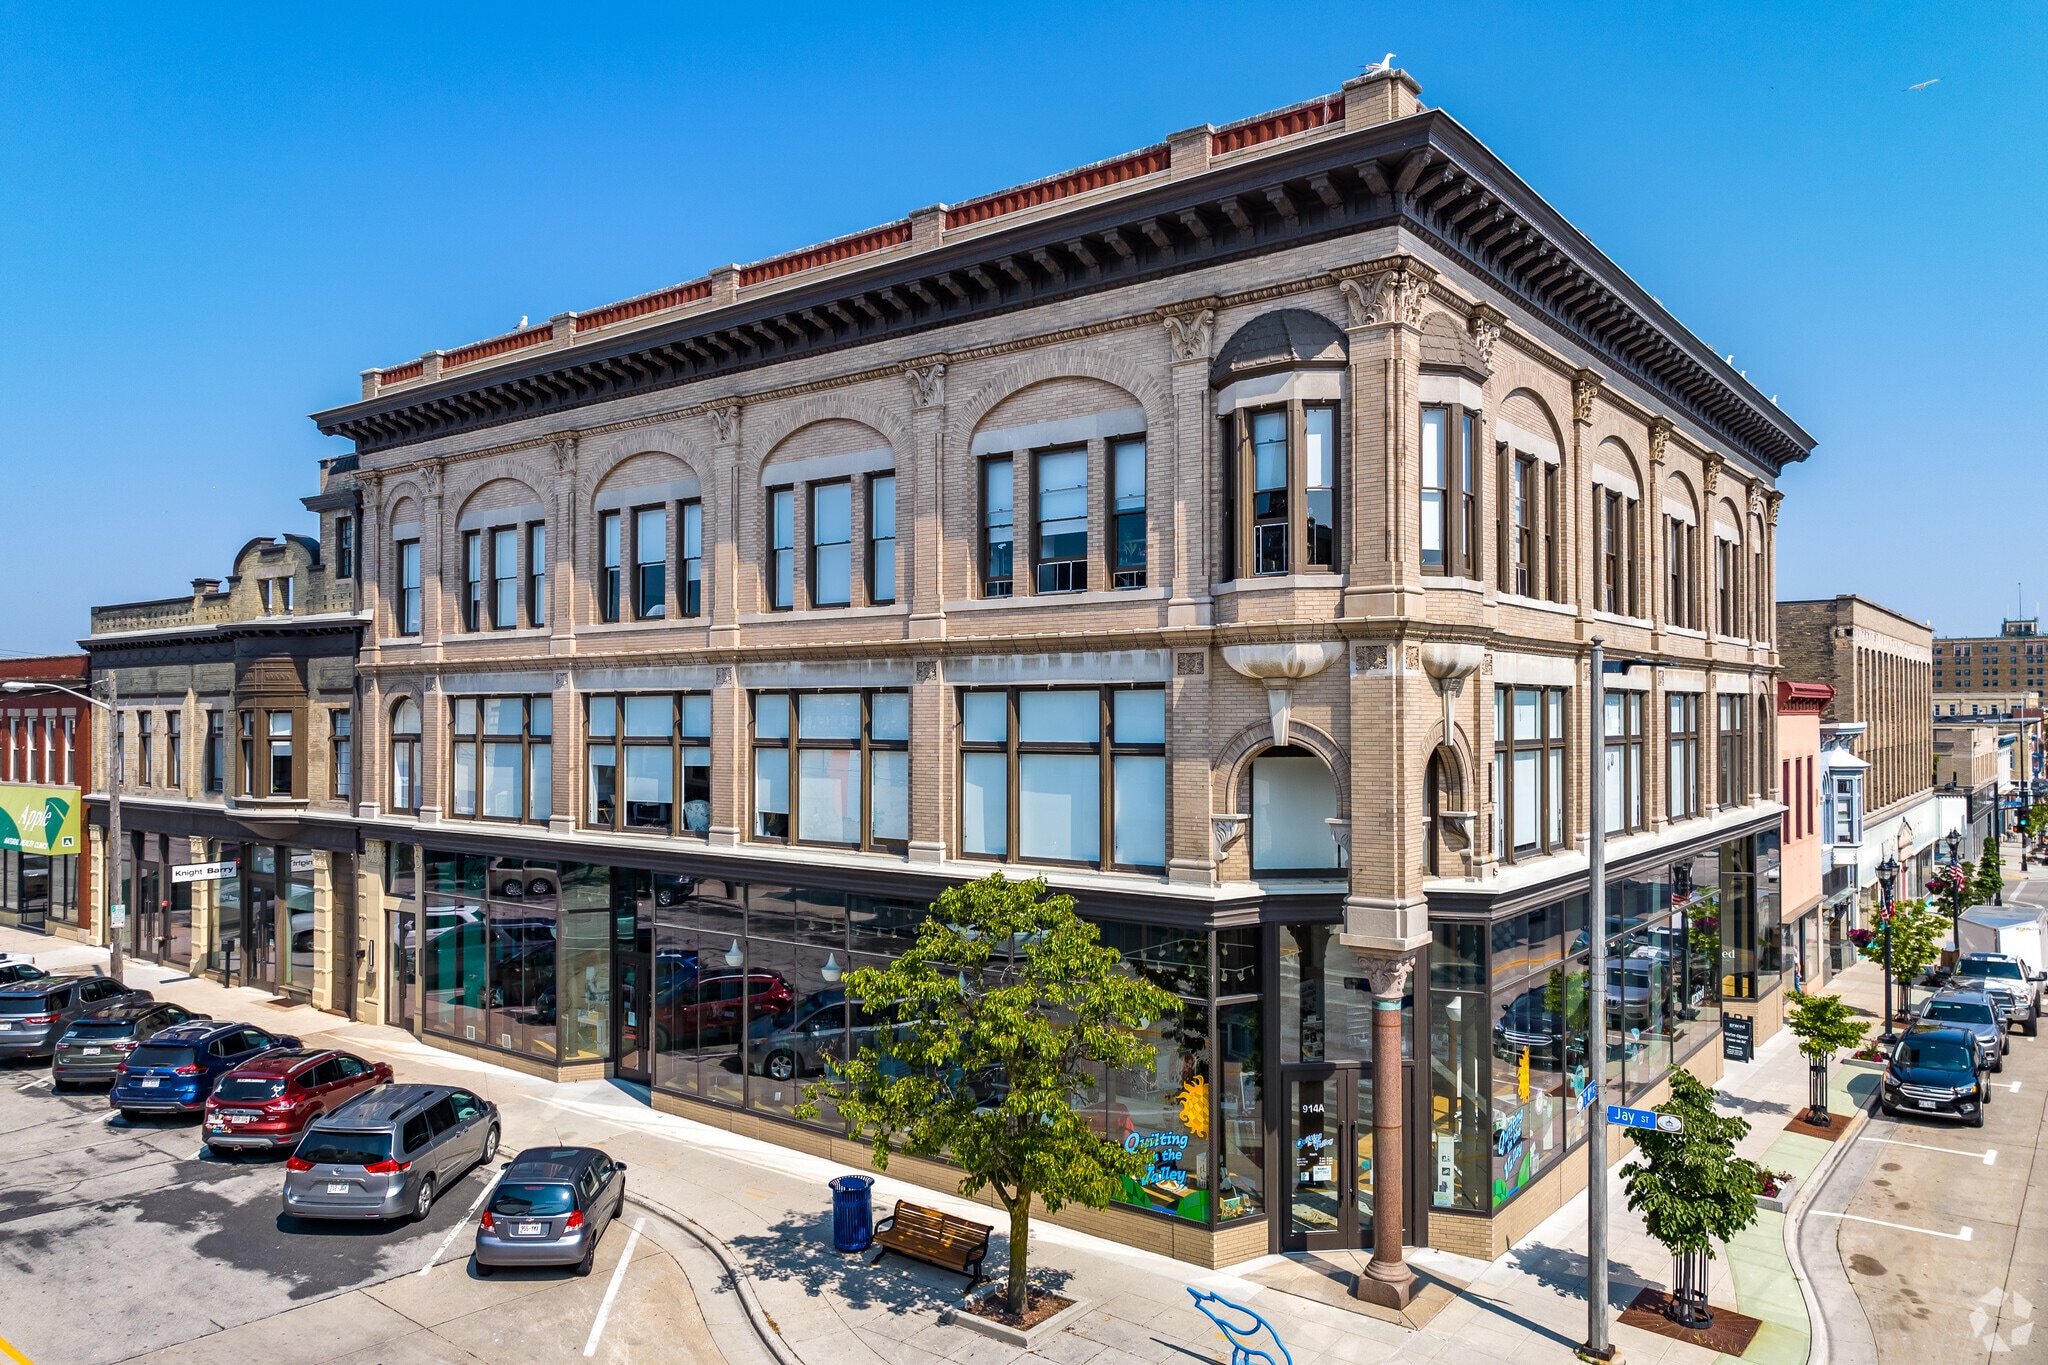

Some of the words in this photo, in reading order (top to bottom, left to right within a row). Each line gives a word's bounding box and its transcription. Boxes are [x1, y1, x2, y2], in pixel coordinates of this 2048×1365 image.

[18, 804, 52, 832] Apple
[3, 837, 20, 846] NATURAL
[19, 839, 35, 848] HEALTH
[175, 869, 203, 877] Knight
[1302, 1104, 1325, 1113] 914A
[1614, 1108, 1635, 1125] Jay
[1641, 1115, 1649, 1123] ST
[1124, 1130, 1188, 1154] Quilting
[1498, 1107, 1524, 1157] Quilting
[1161, 1147, 1183, 1161] the
[1503, 1140, 1523, 1182] Valley
[1141, 1163, 1187, 1186] Valley
